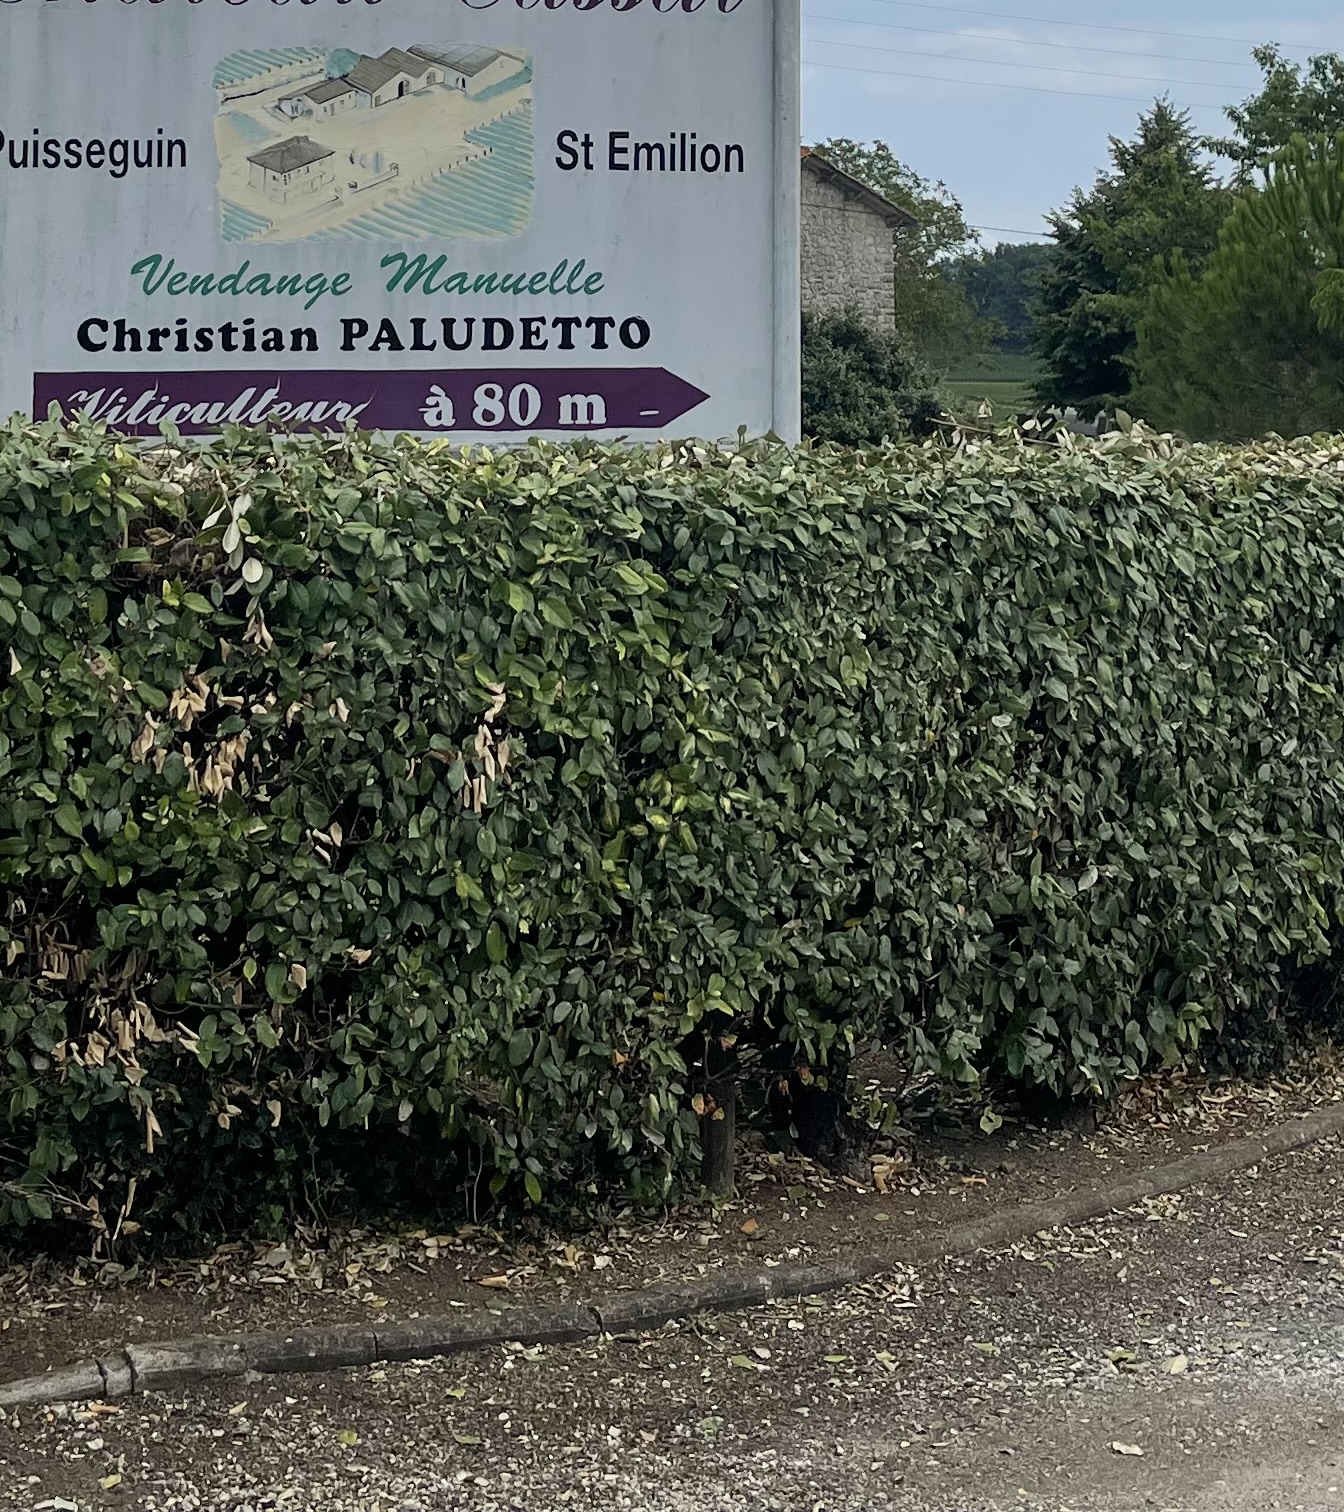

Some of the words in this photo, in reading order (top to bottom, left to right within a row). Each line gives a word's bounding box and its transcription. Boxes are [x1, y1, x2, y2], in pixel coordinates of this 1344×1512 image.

[555, 130, 594, 171] St
[609, 131, 744, 173] Emilion
[131, 253, 353, 310] Vendange
[380, 251, 605, 296] Manuelle
[77, 317, 319, 353] Christian
[340, 315, 651, 352] PALUDETTO
[68, 376, 376, 426] Viticulteur
[418, 384, 455, 427] à
[472, 382, 542, 427] 80
[558, 393, 607, 426] m
